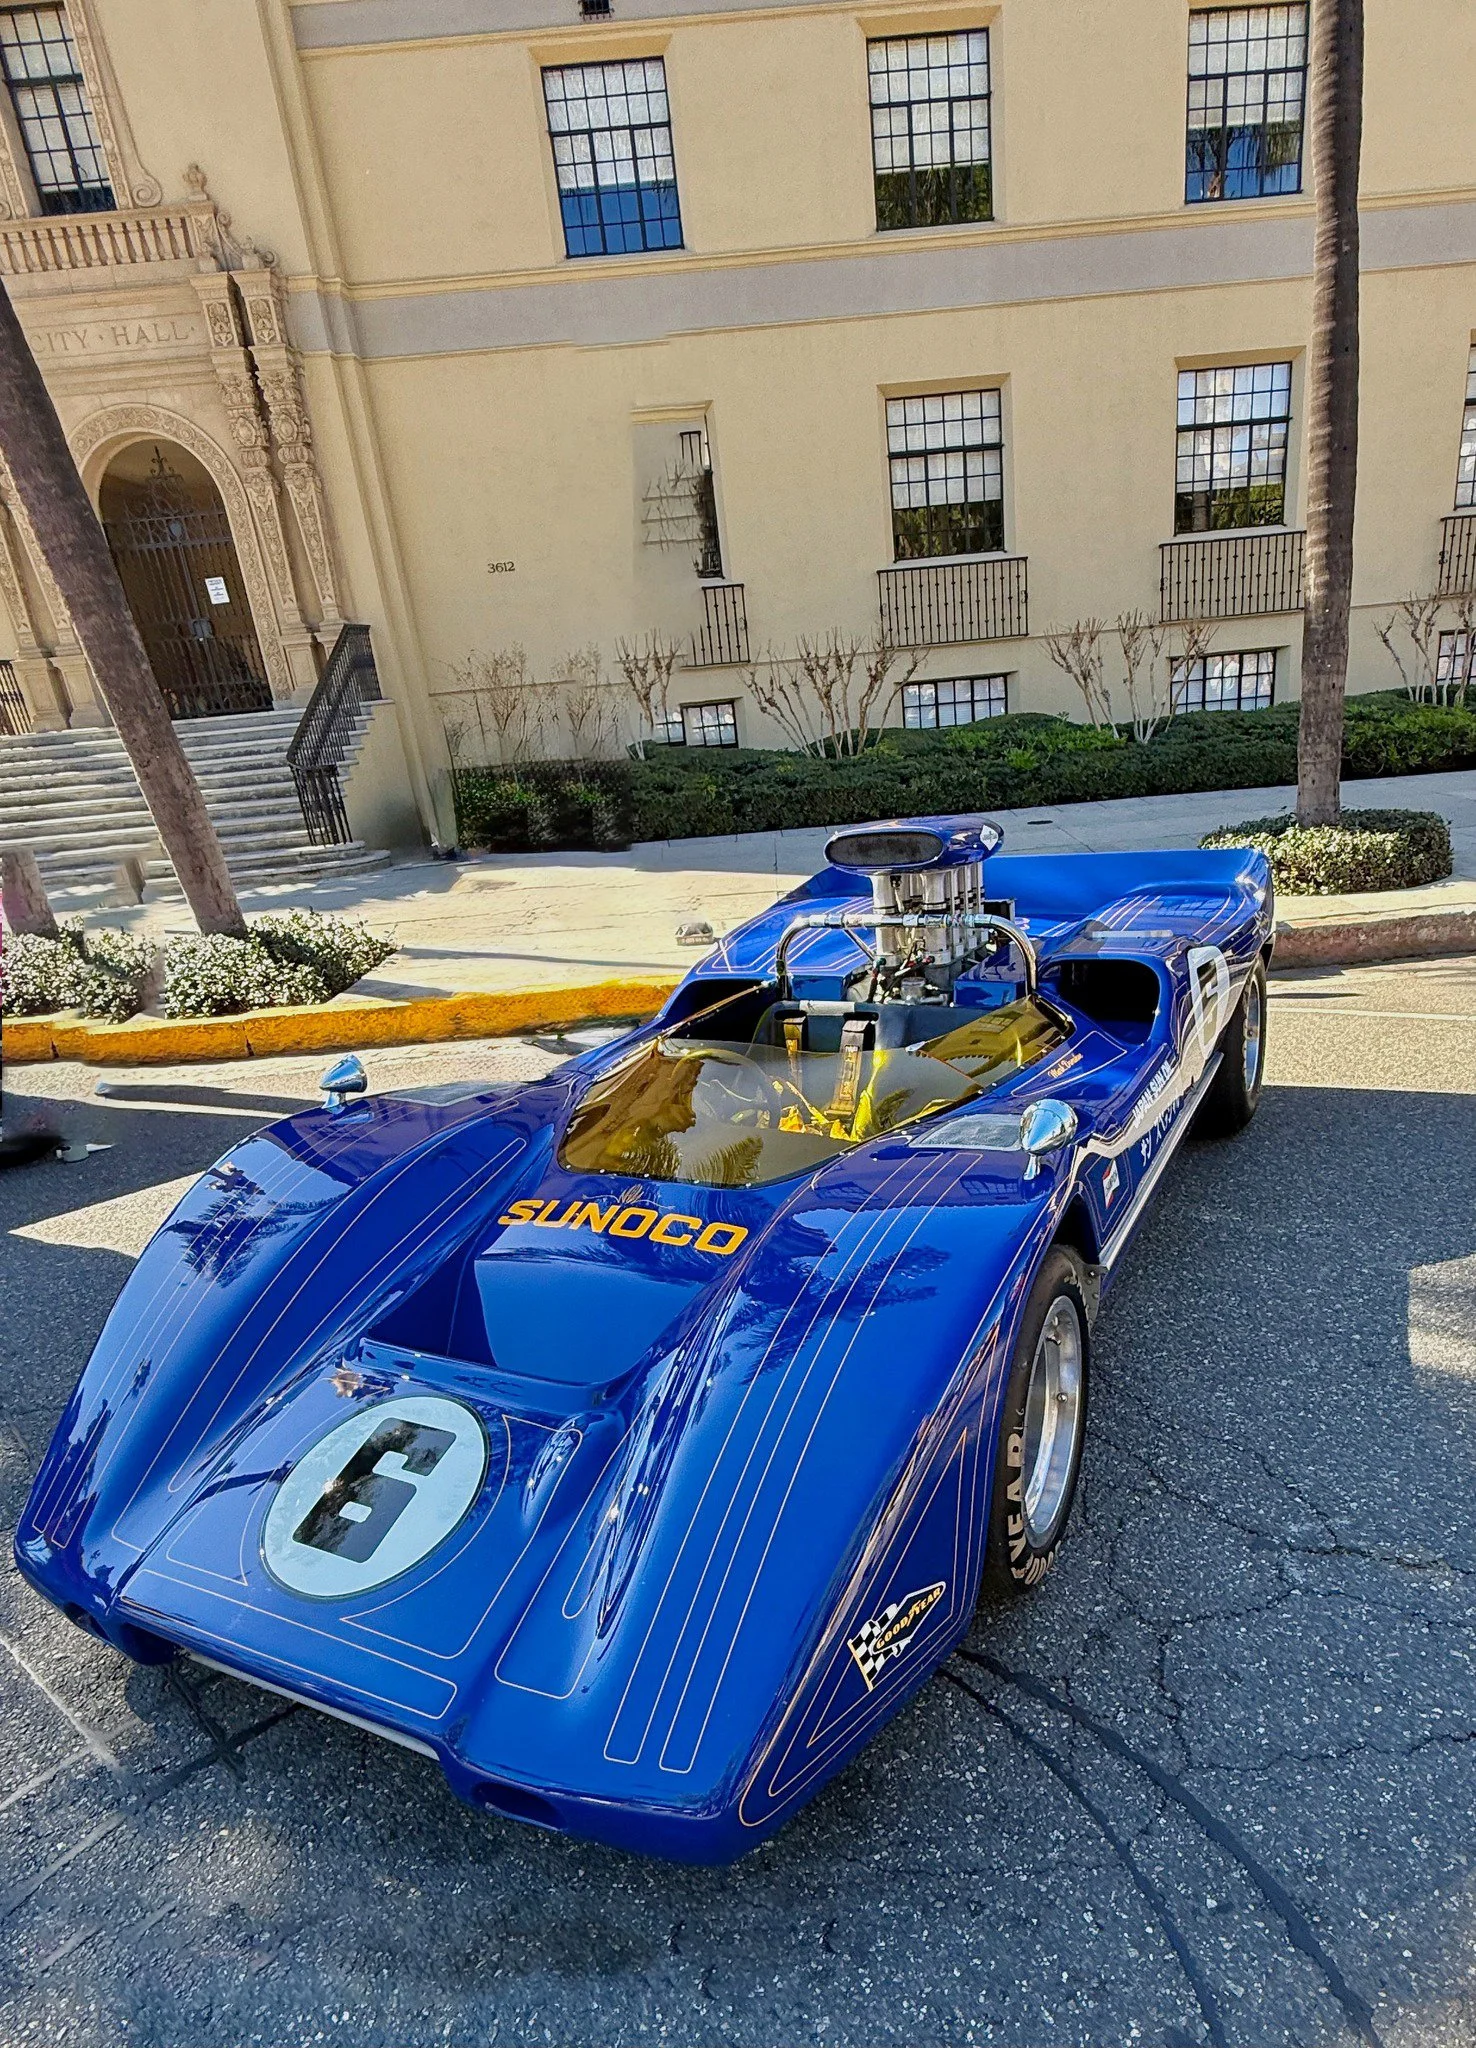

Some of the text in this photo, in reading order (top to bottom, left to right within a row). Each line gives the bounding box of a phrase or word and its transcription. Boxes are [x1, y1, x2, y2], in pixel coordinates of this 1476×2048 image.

[29, 320, 189, 353] CITY HALL
[487, 561, 516, 574] 3612
[497, 1199, 749, 1255] SUNOCO
[292, 1417, 457, 1564] 6
[876, 1587, 941, 1650] GOODYEAR
